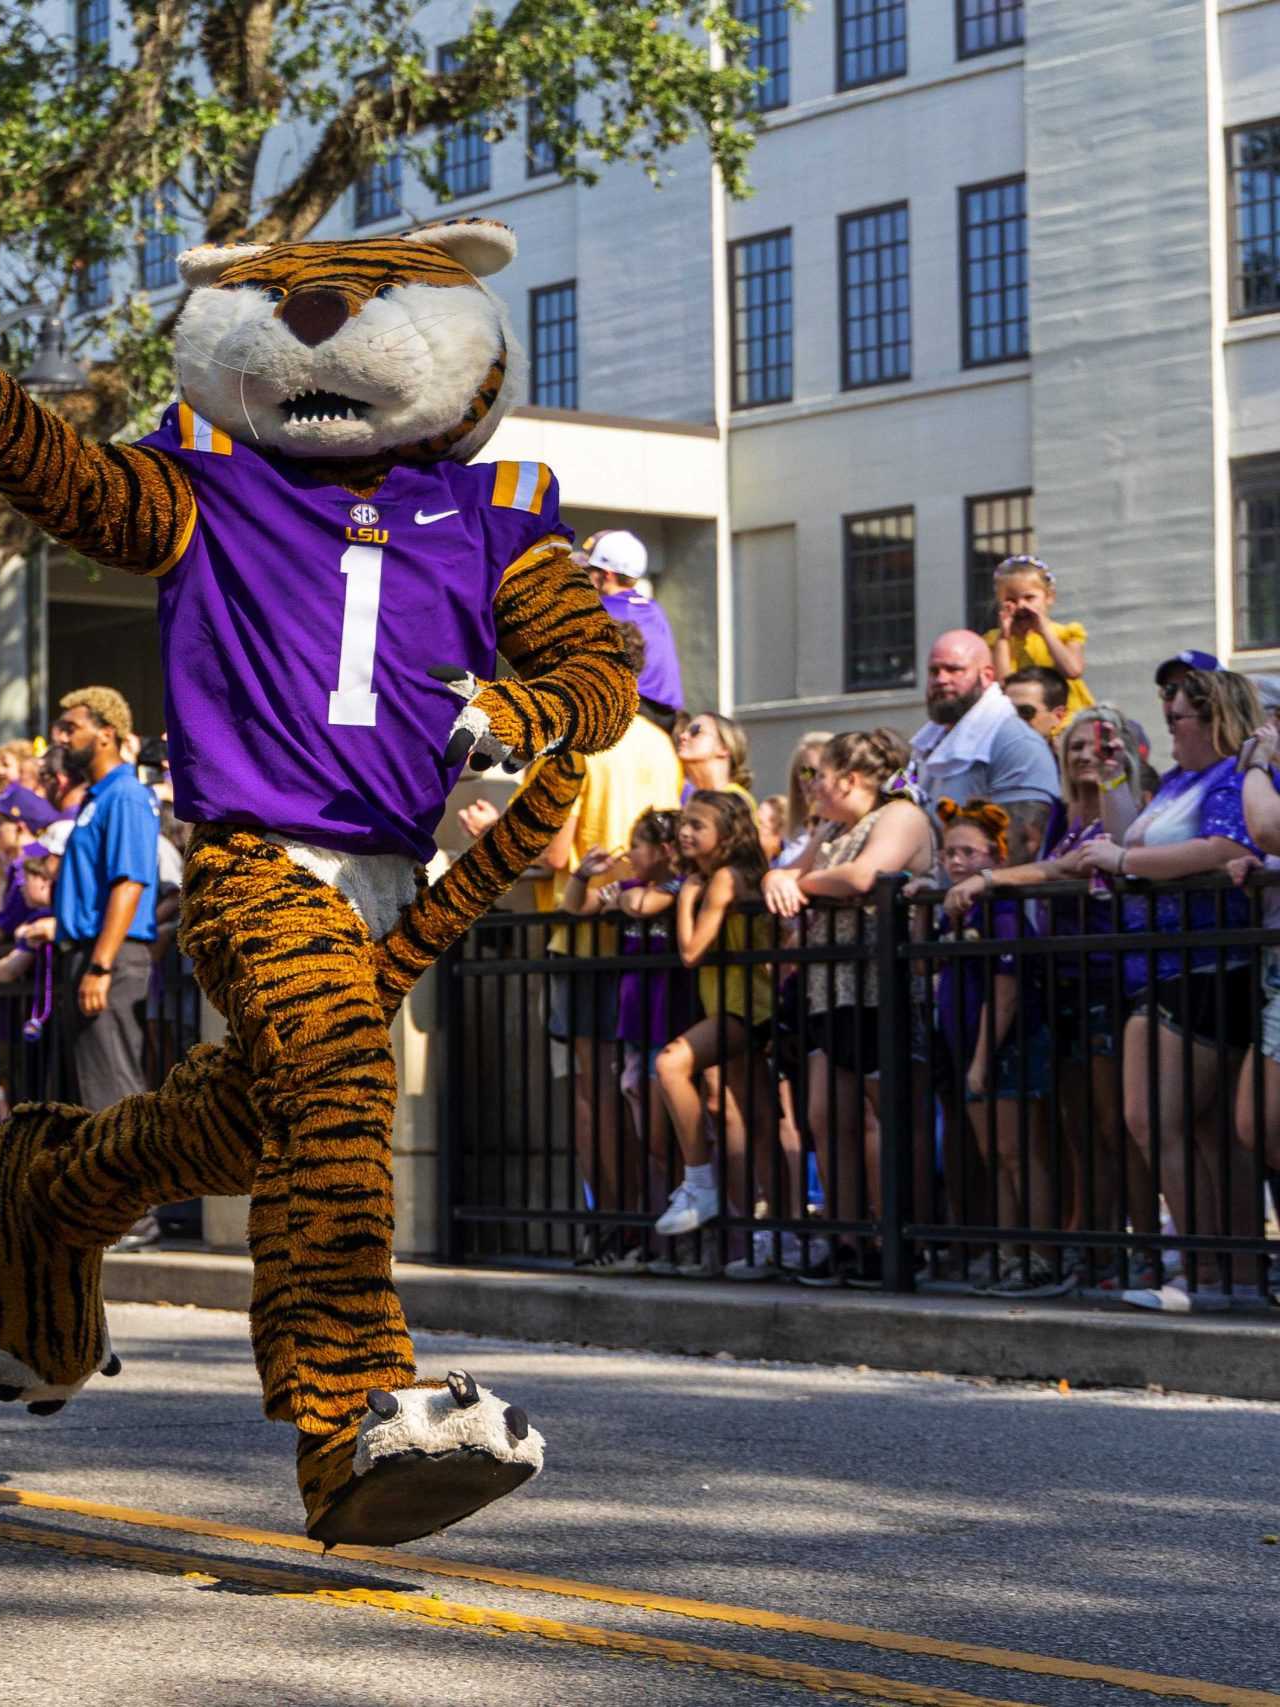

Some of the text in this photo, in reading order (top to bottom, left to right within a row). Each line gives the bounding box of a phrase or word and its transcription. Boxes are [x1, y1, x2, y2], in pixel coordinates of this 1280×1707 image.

[352, 506, 379, 524] SEC
[345, 526, 390, 544] LSU
[328, 545, 384, 727] 1
